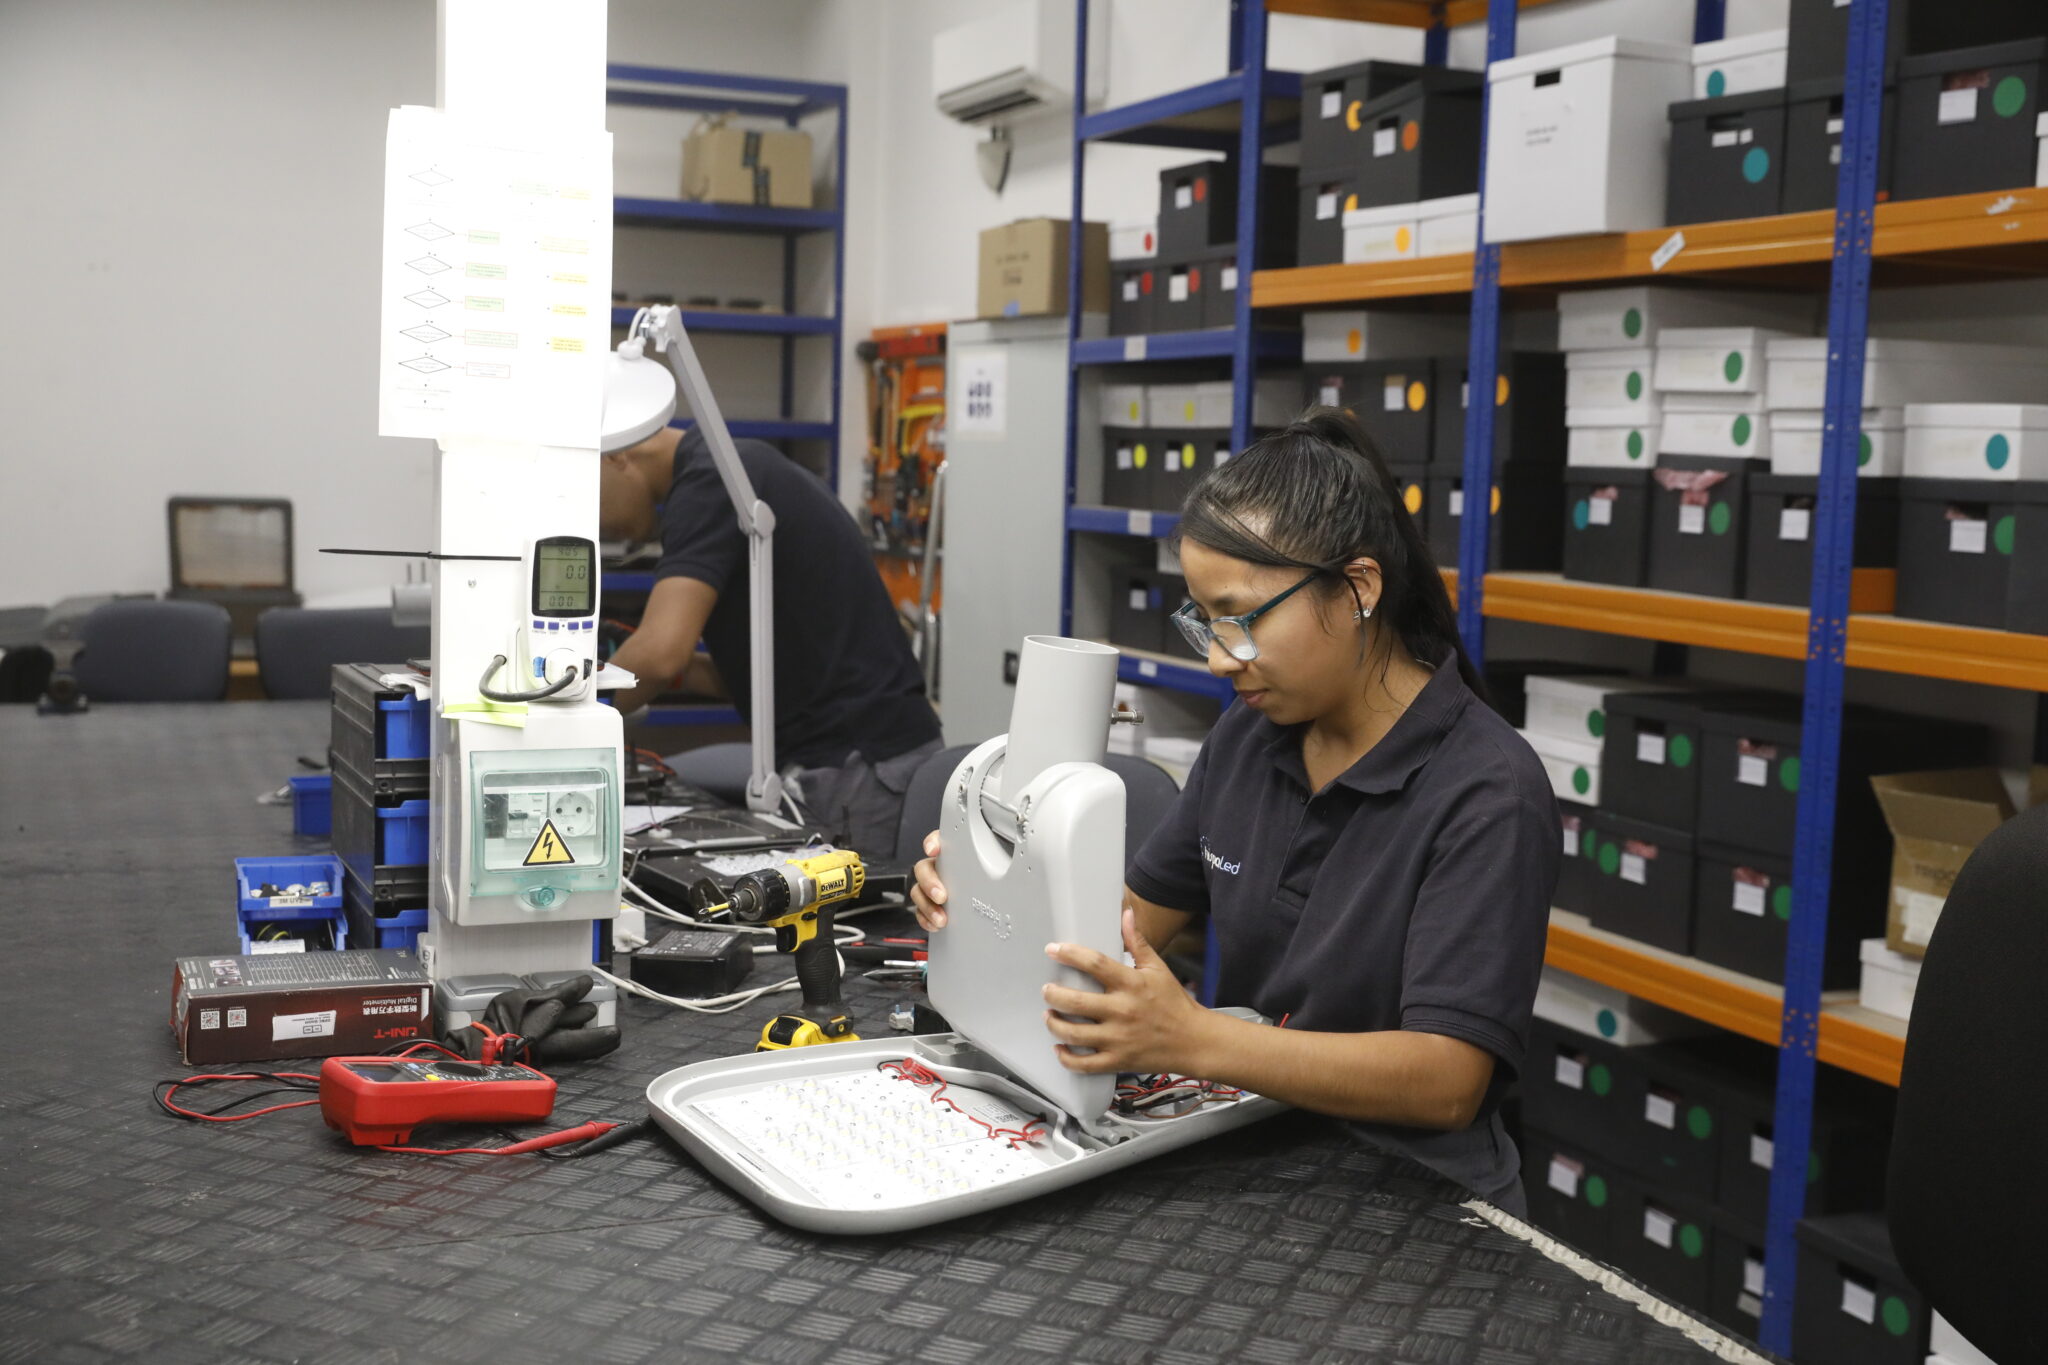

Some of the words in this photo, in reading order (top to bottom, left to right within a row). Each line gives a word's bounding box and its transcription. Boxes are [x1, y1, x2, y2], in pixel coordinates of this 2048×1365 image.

[362, 997, 396, 1006] Multimeter
[397, 996, 417, 1004] Digital
[373, 1026, 417, 1039] UNI-T
